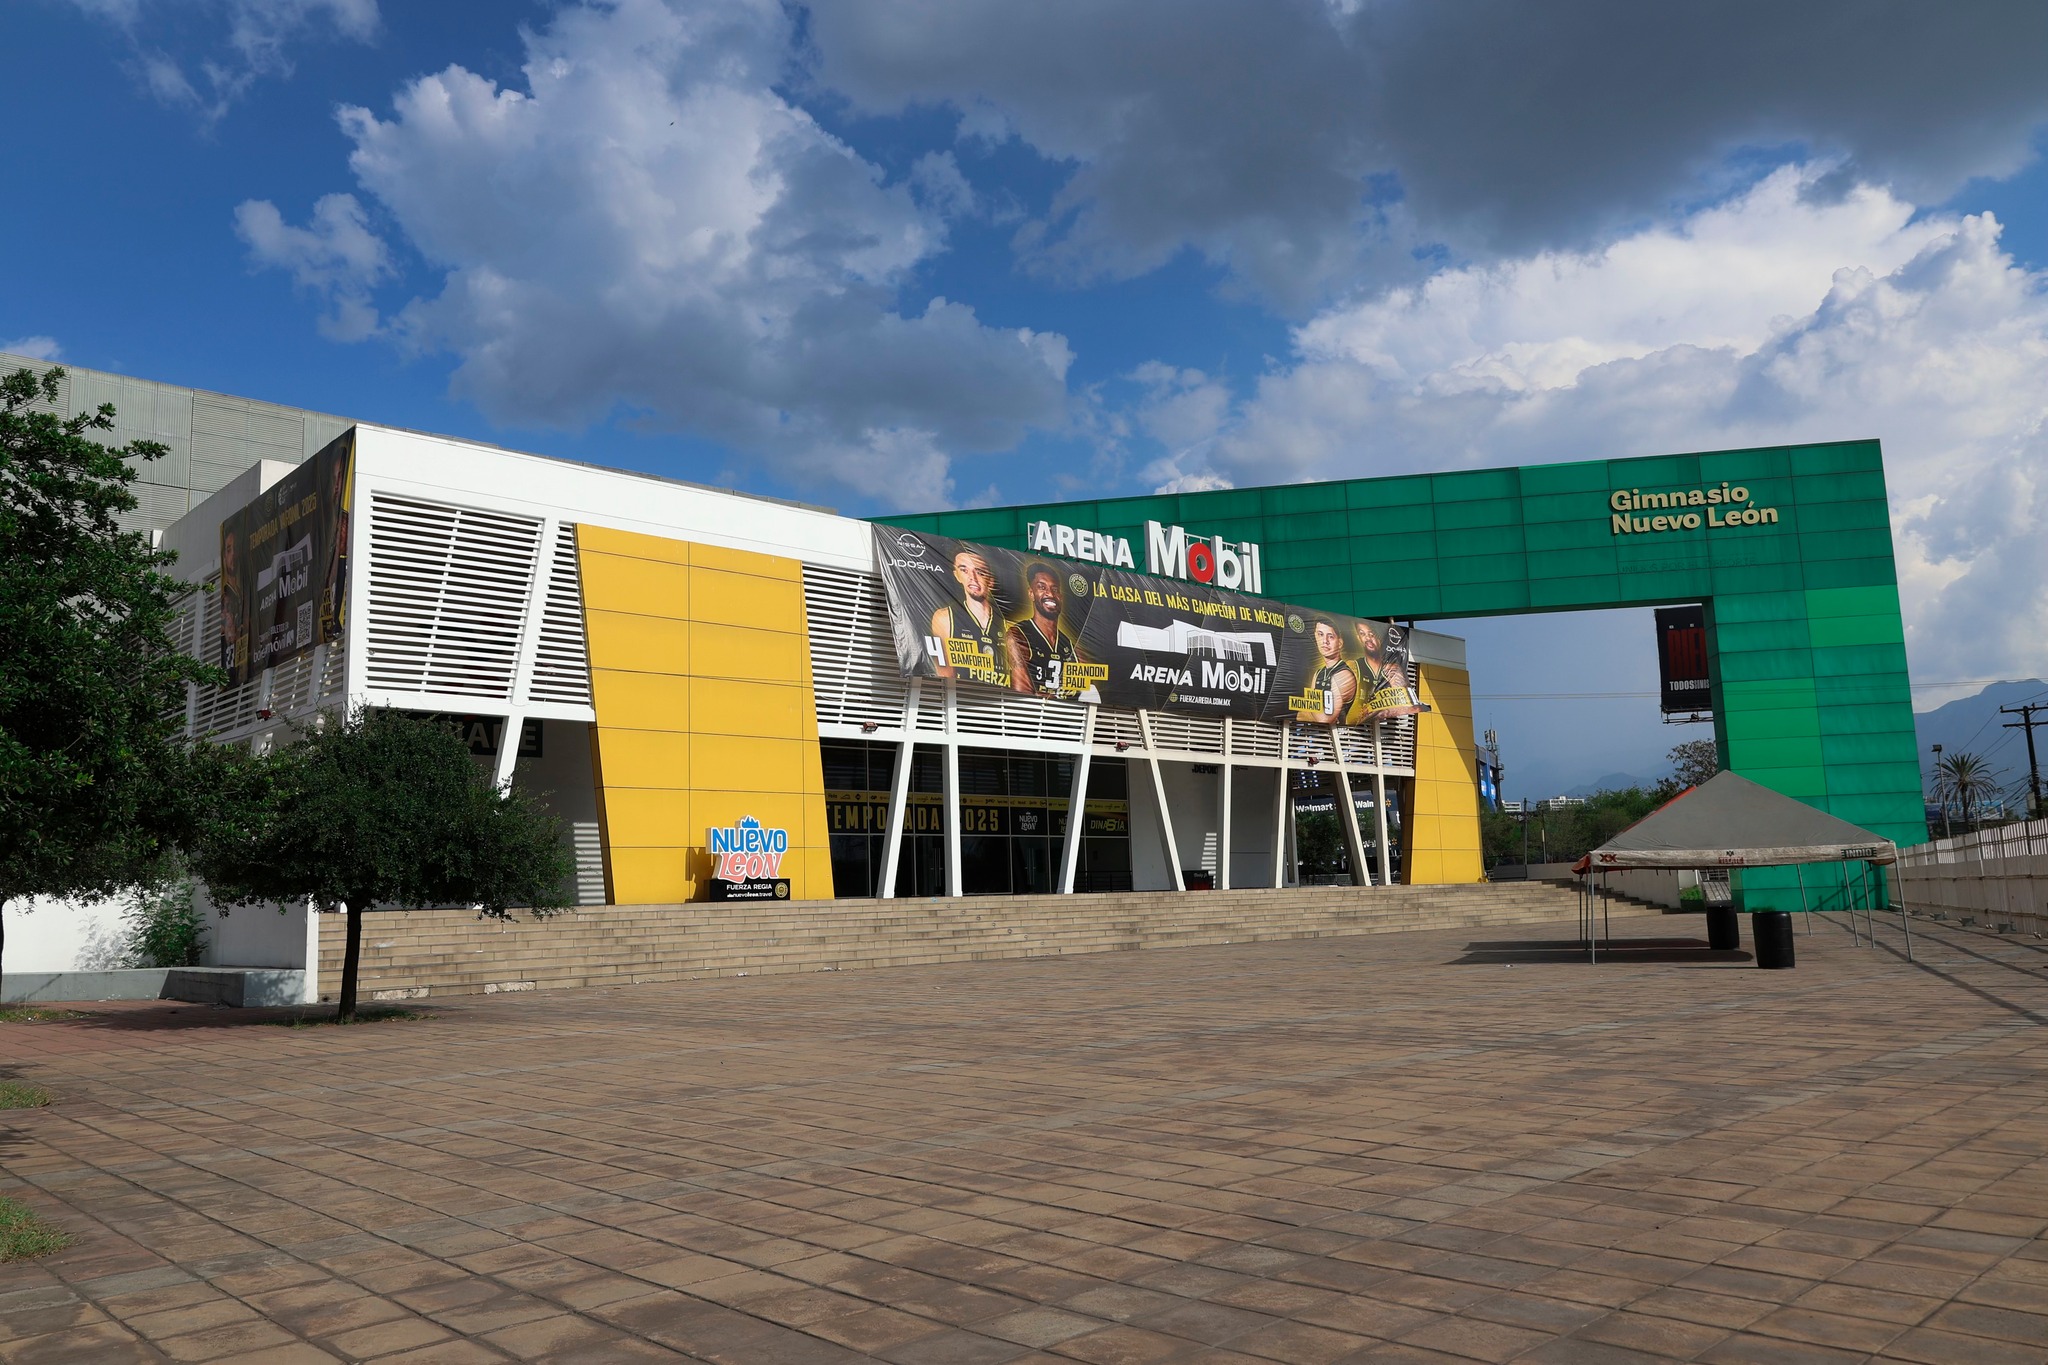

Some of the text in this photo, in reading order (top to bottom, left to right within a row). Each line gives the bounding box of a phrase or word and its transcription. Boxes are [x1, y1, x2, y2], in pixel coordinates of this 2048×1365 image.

[1610, 482, 1749, 511] Gimnasio
[1612, 500, 1778, 534] Nuevo León
[896, 540, 926, 550] NISSAN
[888, 558, 945, 573] JIDOSHA
[1032, 519, 1262, 594] ARENA Mobil
[279, 565, 308, 599] Mobil
[1093, 581, 1108, 598] LA
[1111, 585, 1142, 604] CASA
[1144, 590, 1164, 607] DEL
[1166, 592, 1190, 611] MÁS
[1192, 599, 1236, 620] CAMPEÓN
[1240, 606, 1253, 622] DE
[1254, 607, 1285, 629] MÉXICO
[924, 635, 946, 667] 4
[948, 640, 974, 653] SCOTT
[950, 652, 992, 669] BAMFORTH
[1066, 664, 1106, 678] BRANDON
[968, 668, 1011, 689] FUERZA
[1045, 660, 1062, 690] 3
[1065, 677, 1087, 689] PAUL
[1130, 661, 1267, 694] ARENA Mobil
[1669, 679, 1695, 691] TODOS
[1179, 695, 1231, 707] FUERZAREGIA.COM.MX
[1324, 690, 1334, 715] 9
[827, 804, 940, 831] EMPOADA
[1295, 803, 1334, 812] Walmart
[1845, 848, 1872, 858] INDIO
